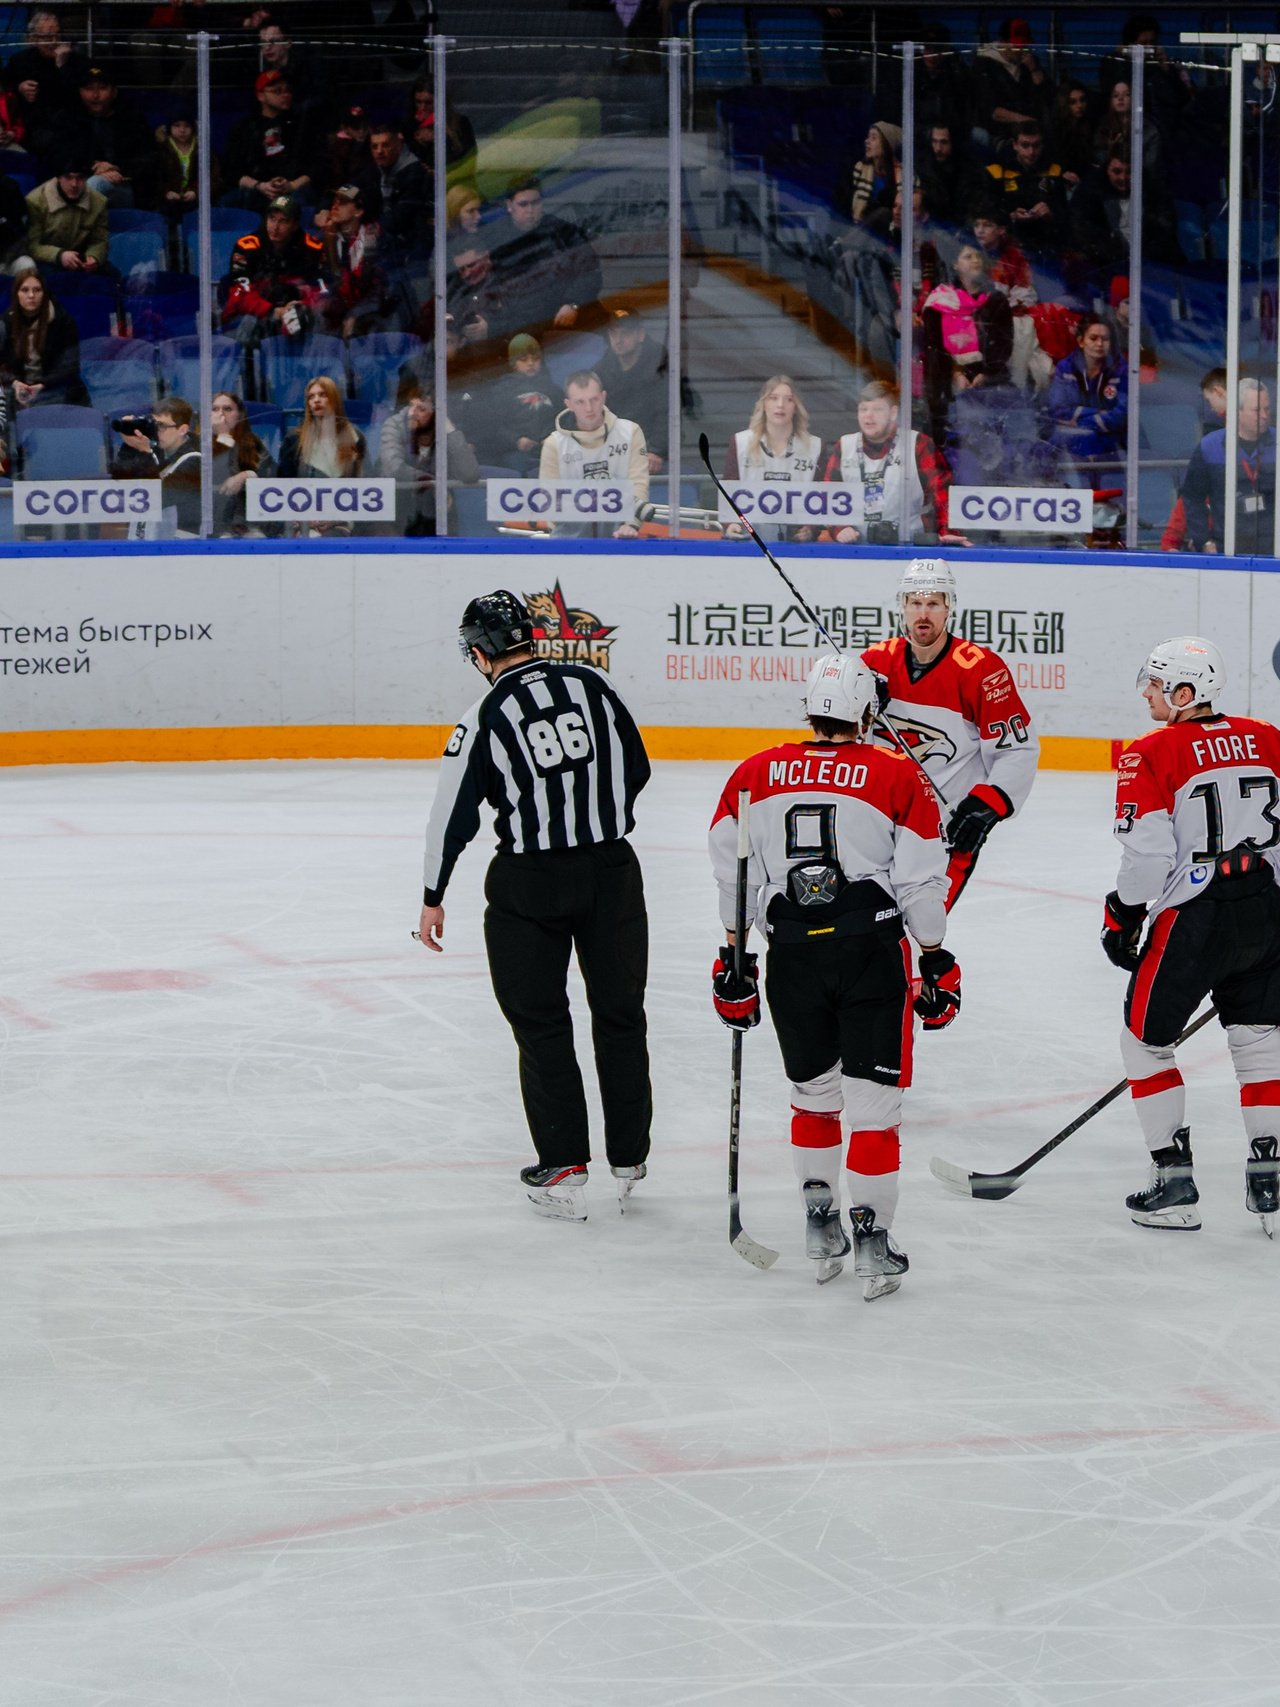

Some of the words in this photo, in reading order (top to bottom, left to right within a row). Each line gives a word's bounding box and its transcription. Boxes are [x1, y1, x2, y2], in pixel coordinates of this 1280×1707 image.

[608, 443, 628, 457] 249
[794, 458, 814, 472] 234
[25, 488, 150, 516] согаз
[259, 486, 384, 513] согаз
[500, 487, 623, 513] согаз
[731, 488, 853, 516] согаз
[961, 495, 1082, 524] согаз
[917, 562, 934, 571] 20
[0, 625, 69, 643] тема
[79, 617, 213, 648] быстрых
[0, 648, 90, 675] тежей
[667, 655, 742, 681] BEIJING
[751, 656, 818, 682] KUNLU
[1017, 663, 1065, 690] CLUB
[823, 698, 832, 714] 9
[526, 711, 590, 769] 86
[988, 714, 1029, 750] 20
[1191, 734, 1260, 767] FIORE
[768, 759, 868, 789] MCLEOD
